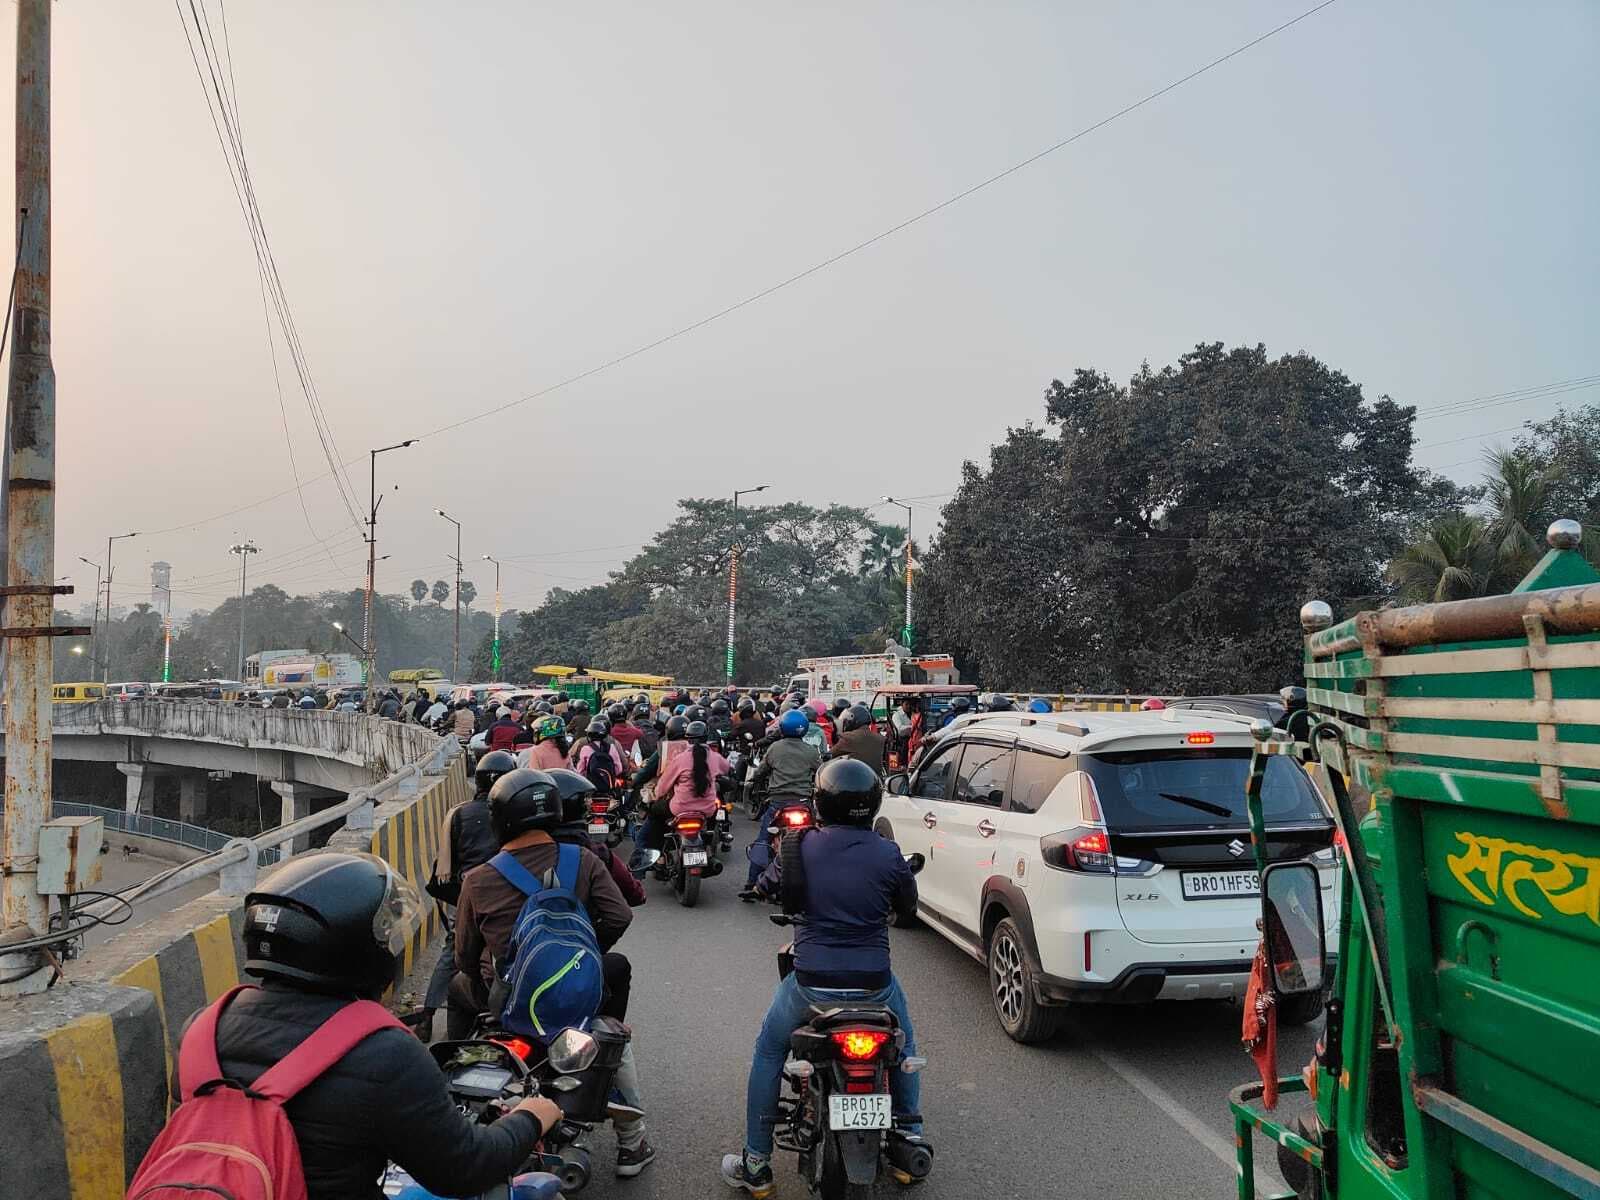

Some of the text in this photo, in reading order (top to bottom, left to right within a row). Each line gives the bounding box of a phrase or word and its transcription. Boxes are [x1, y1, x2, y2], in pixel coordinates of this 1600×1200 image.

[1122, 893, 1161, 901] XL6
[842, 1097, 884, 1111] BR01F
[842, 1112, 885, 1127] L4572
